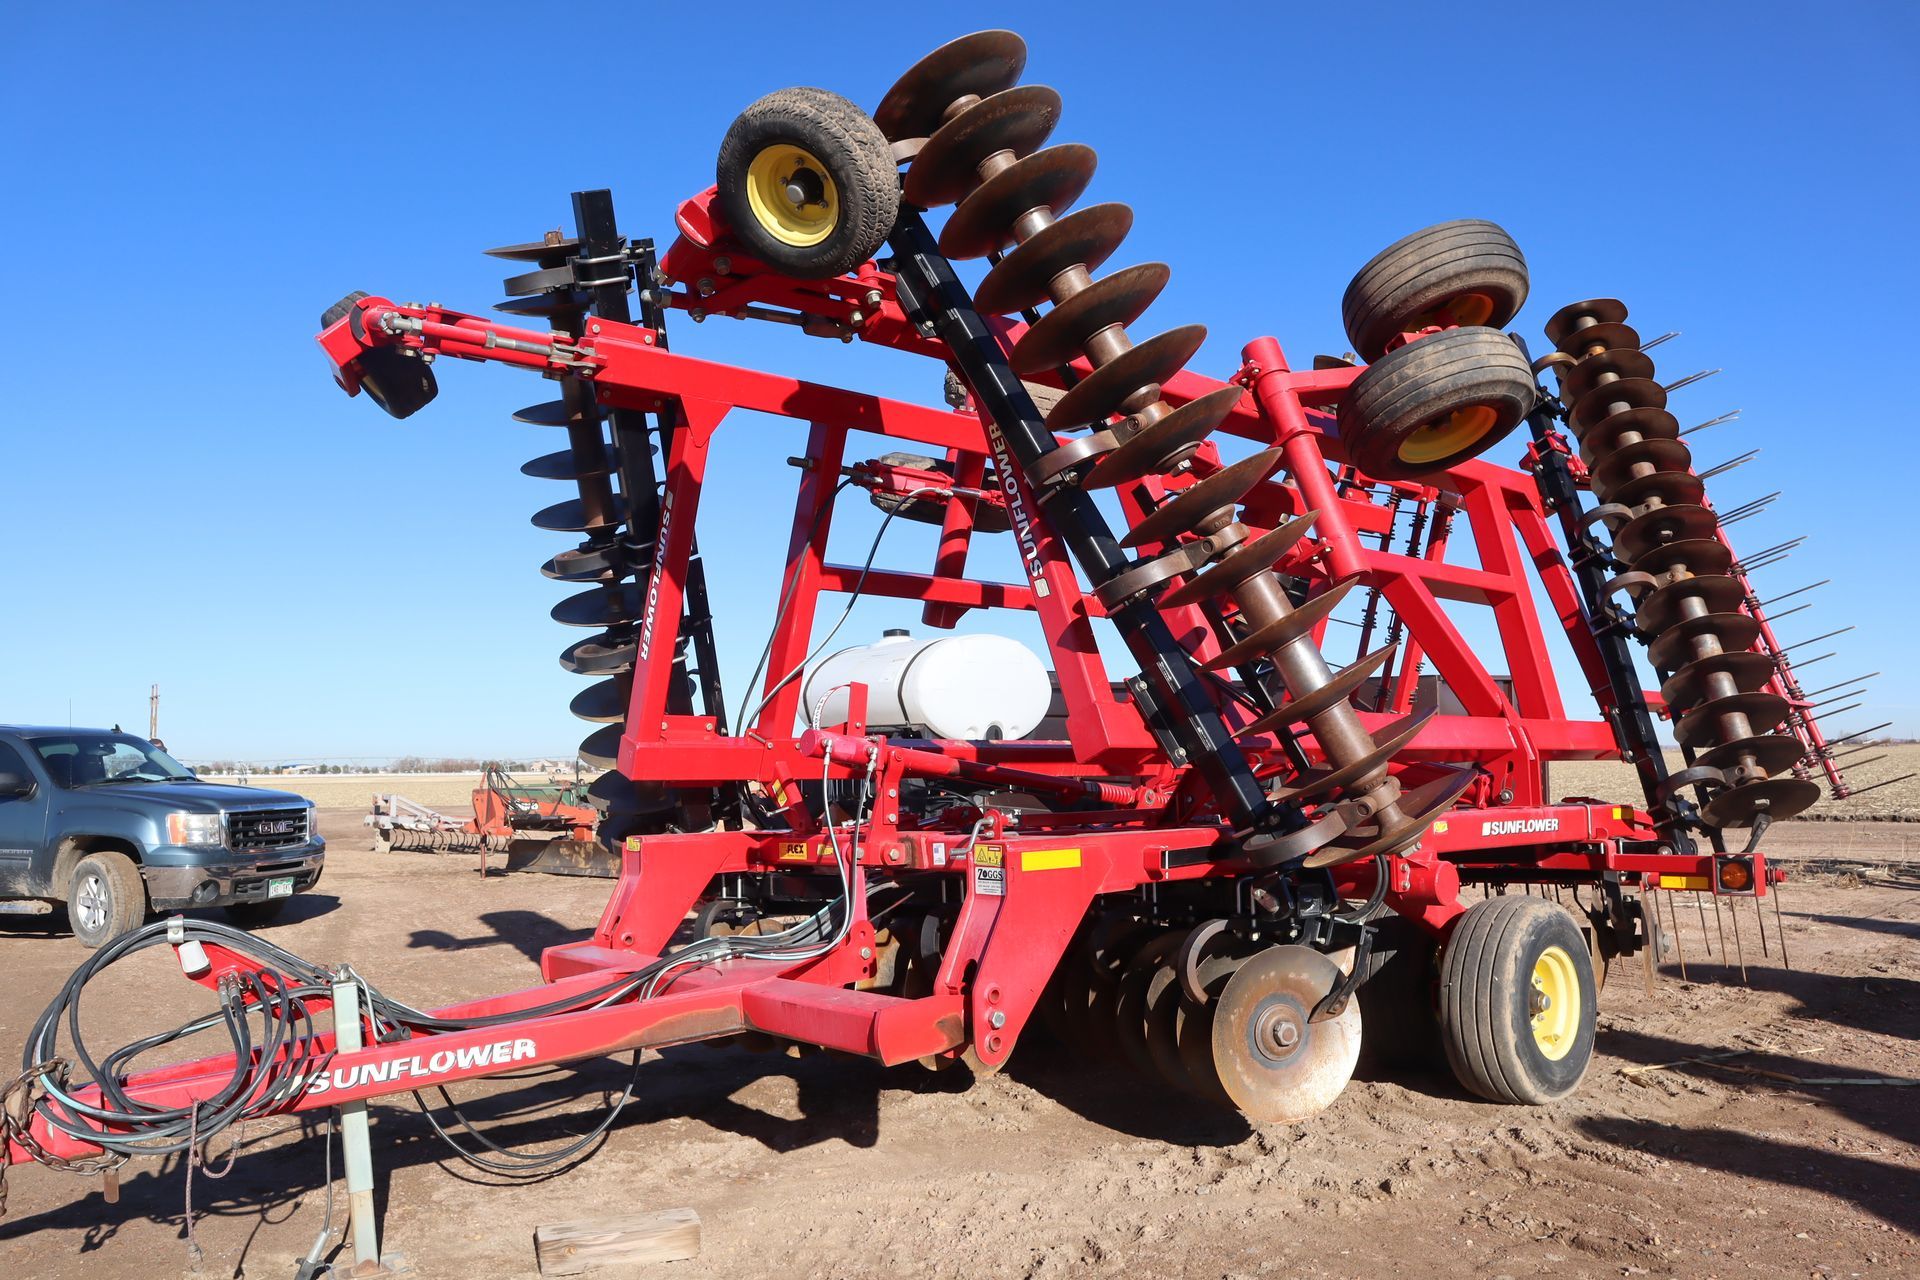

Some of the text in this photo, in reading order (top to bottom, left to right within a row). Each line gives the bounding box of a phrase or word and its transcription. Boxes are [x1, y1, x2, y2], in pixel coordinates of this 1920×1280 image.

[989, 421, 1043, 577] SUNFLOWER
[641, 509, 670, 661] SUNFLOWER
[259, 820, 294, 834] GMC
[1491, 819, 1559, 835] SUNFLOWER
[306, 1038, 537, 1095] SUNFLOWER
